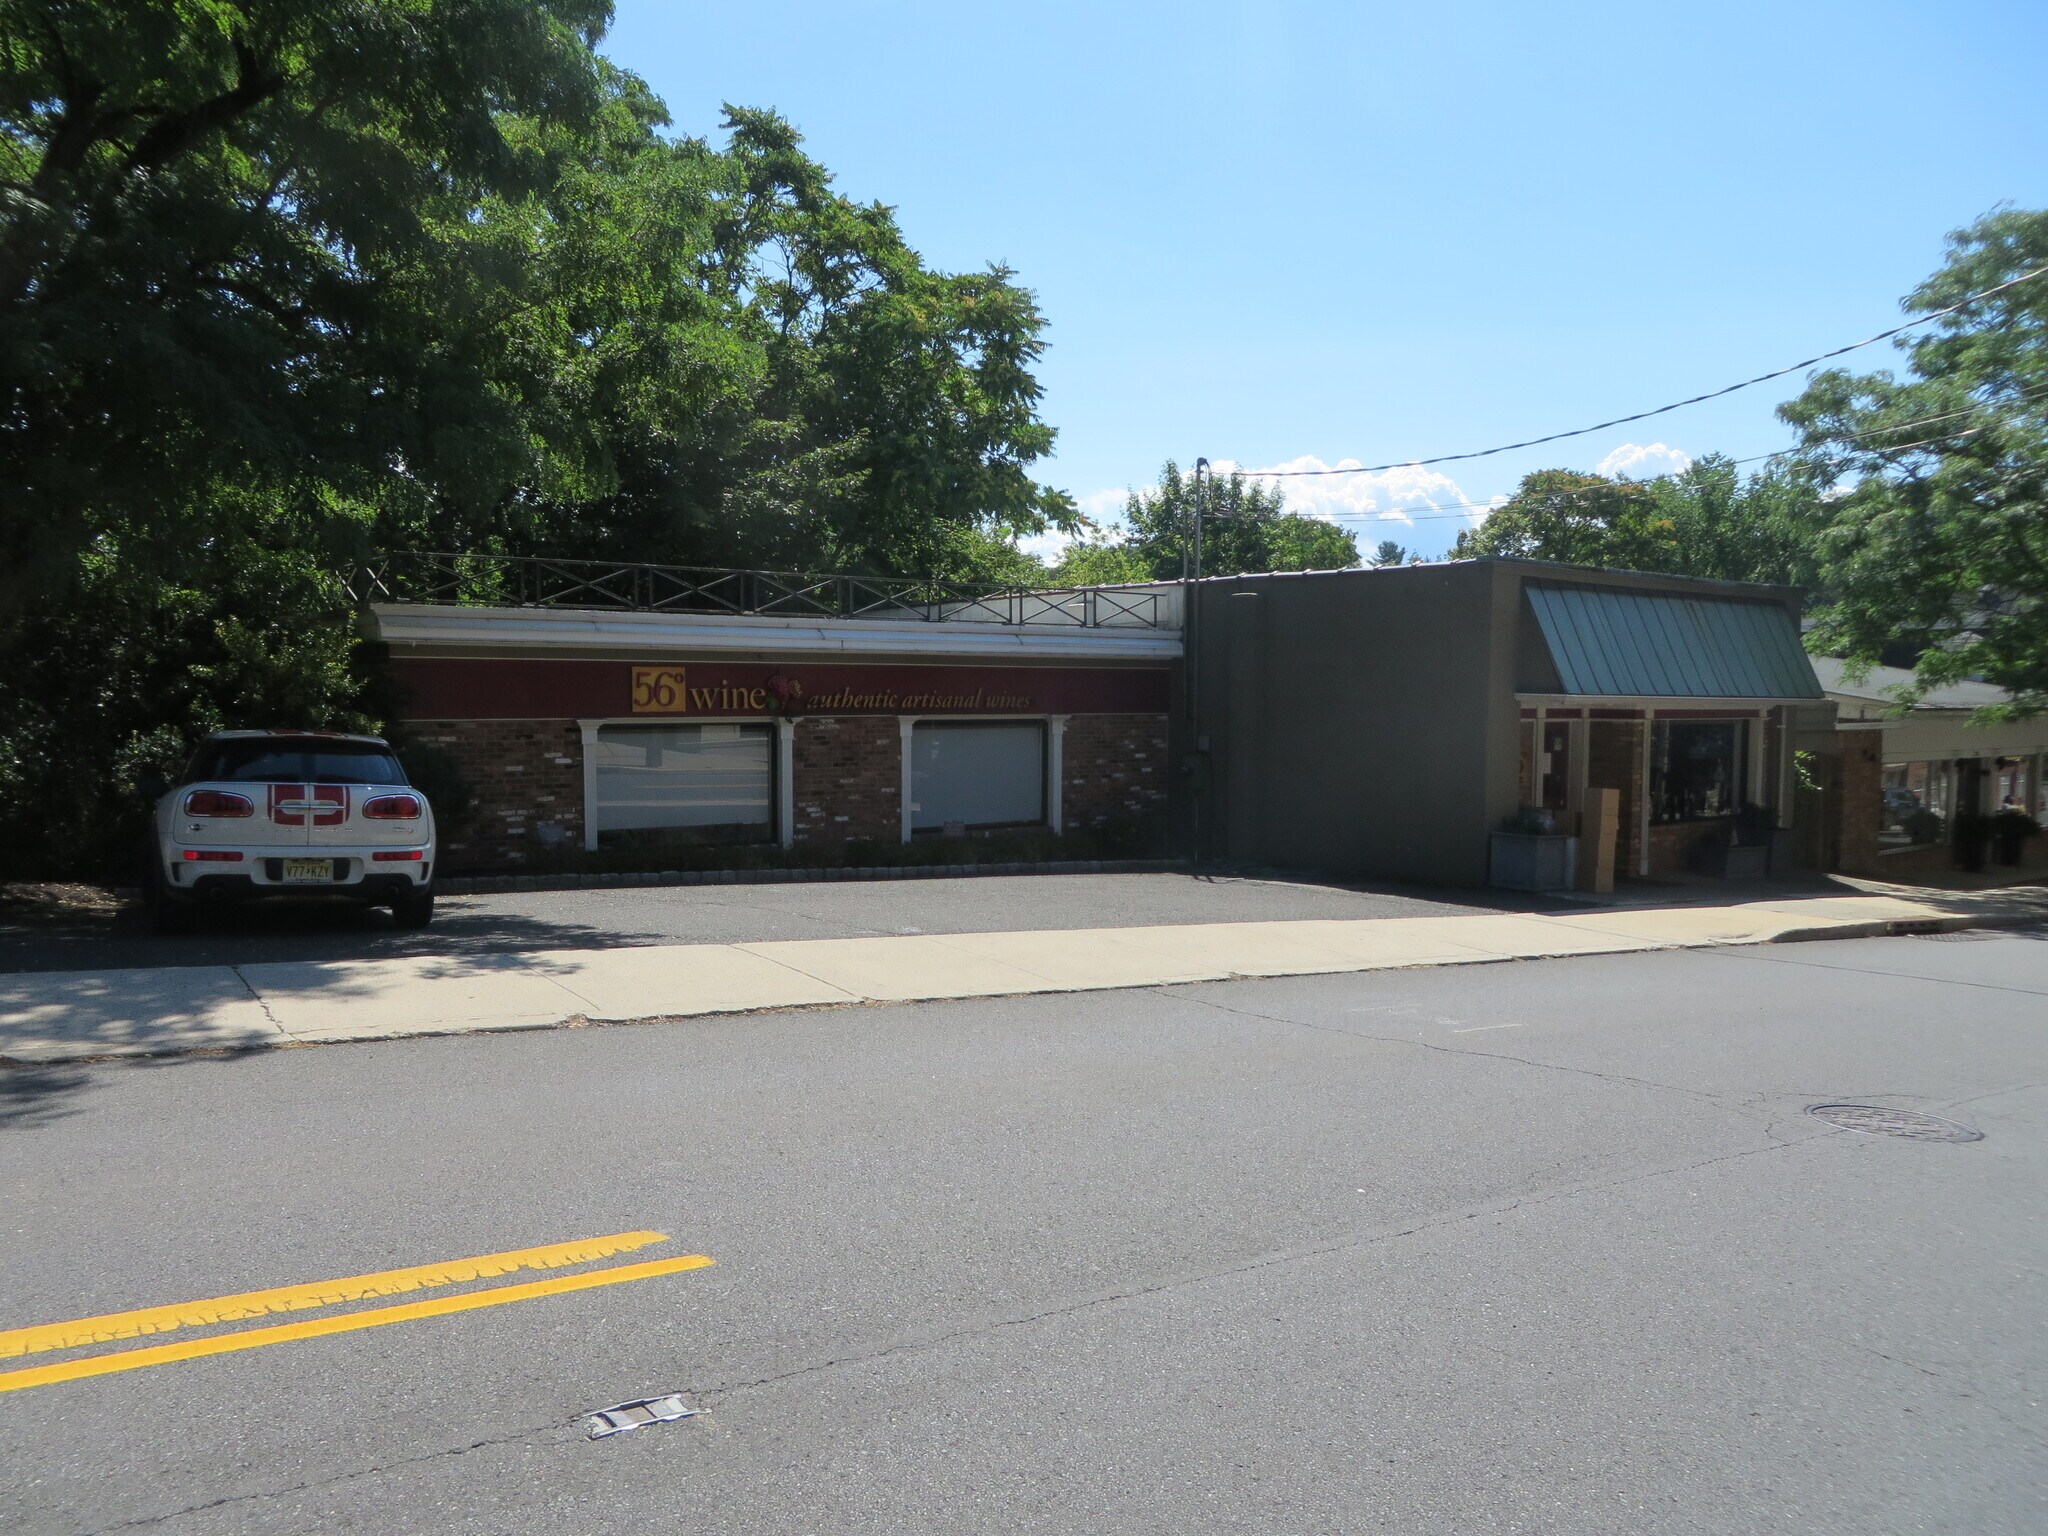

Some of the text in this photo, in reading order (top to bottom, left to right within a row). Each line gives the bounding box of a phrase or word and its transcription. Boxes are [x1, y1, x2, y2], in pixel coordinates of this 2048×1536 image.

[688, 680, 767, 711] wine
[806, 687, 1032, 710] authentic artisanal wines
